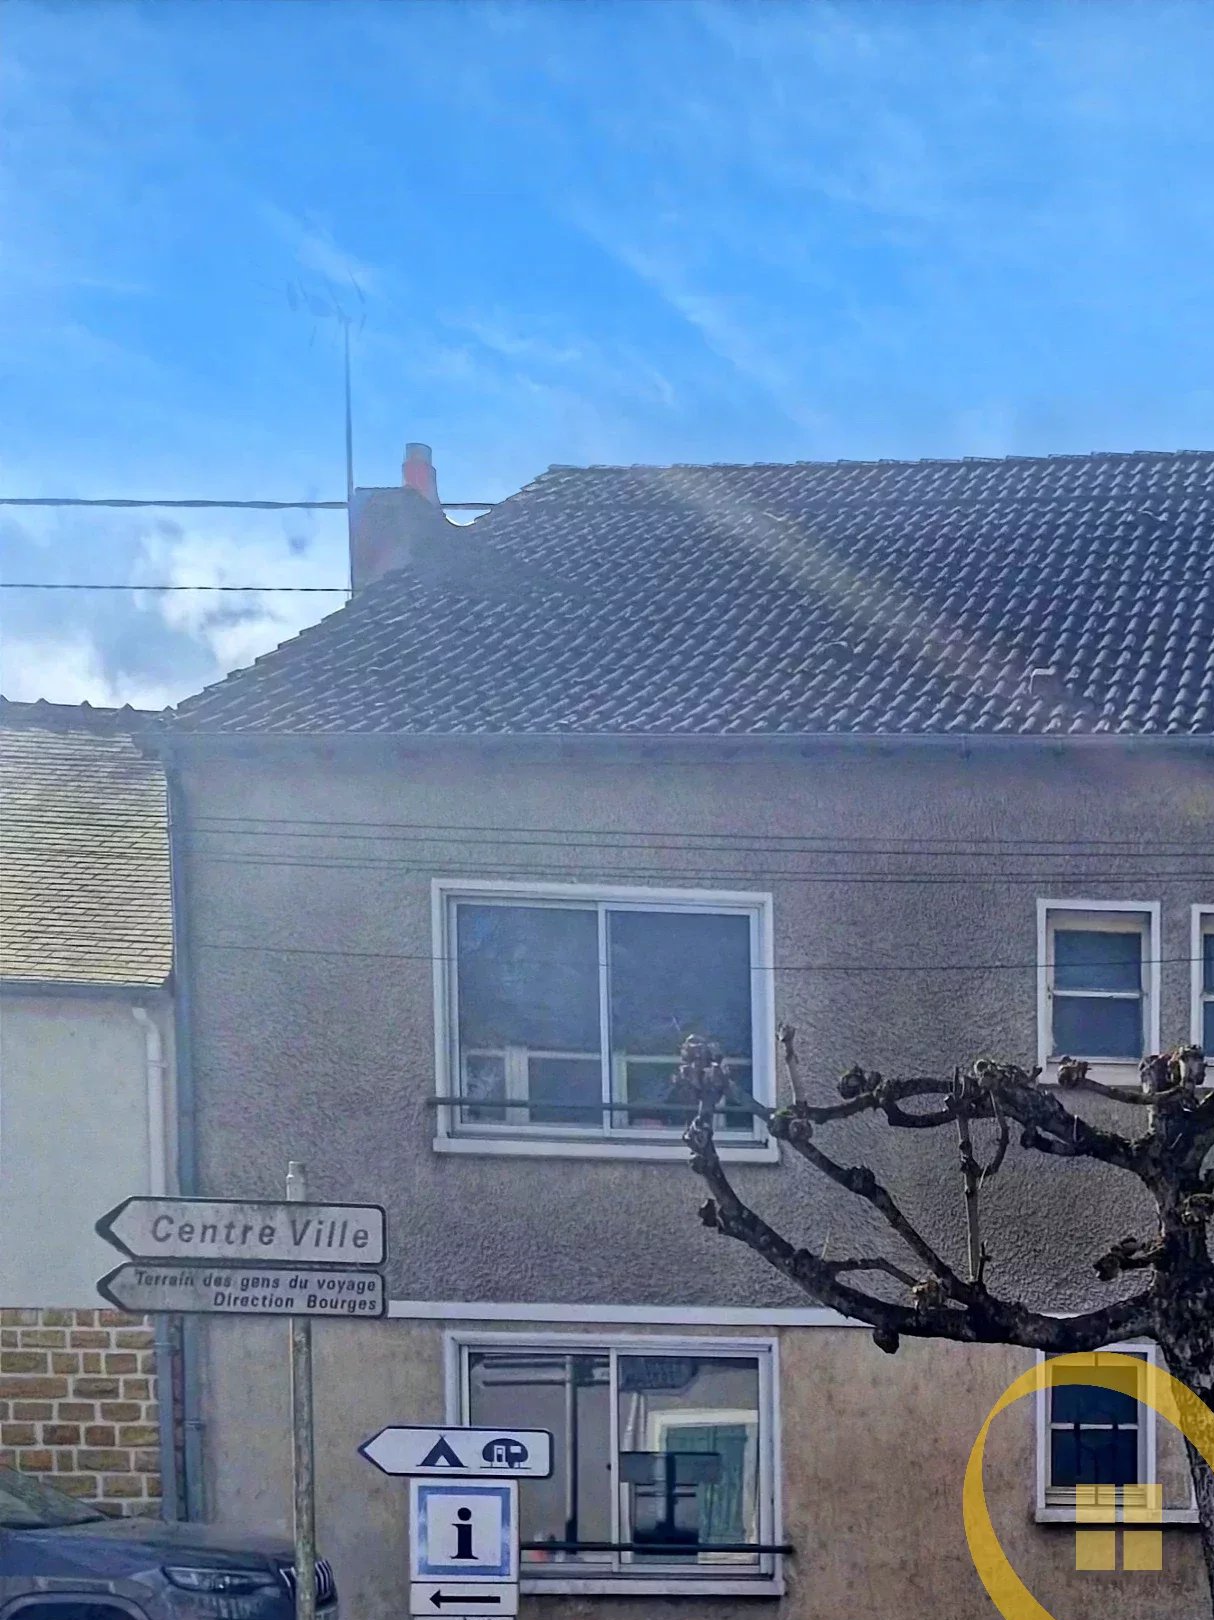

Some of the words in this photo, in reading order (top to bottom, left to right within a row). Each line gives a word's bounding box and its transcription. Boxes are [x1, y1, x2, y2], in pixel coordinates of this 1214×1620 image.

[151, 1214, 276, 1245] Centre
[291, 1219, 369, 1248] Ville
[134, 1269, 194, 1286] Terrain
[203, 1273, 232, 1287] des
[241, 1277, 280, 1292] gens
[289, 1275, 309, 1289] du
[317, 1278, 376, 1295] voyage
[214, 1291, 294, 1309] Direction
[307, 1294, 377, 1313] Bourges
[449, 1507, 479, 1560] i
